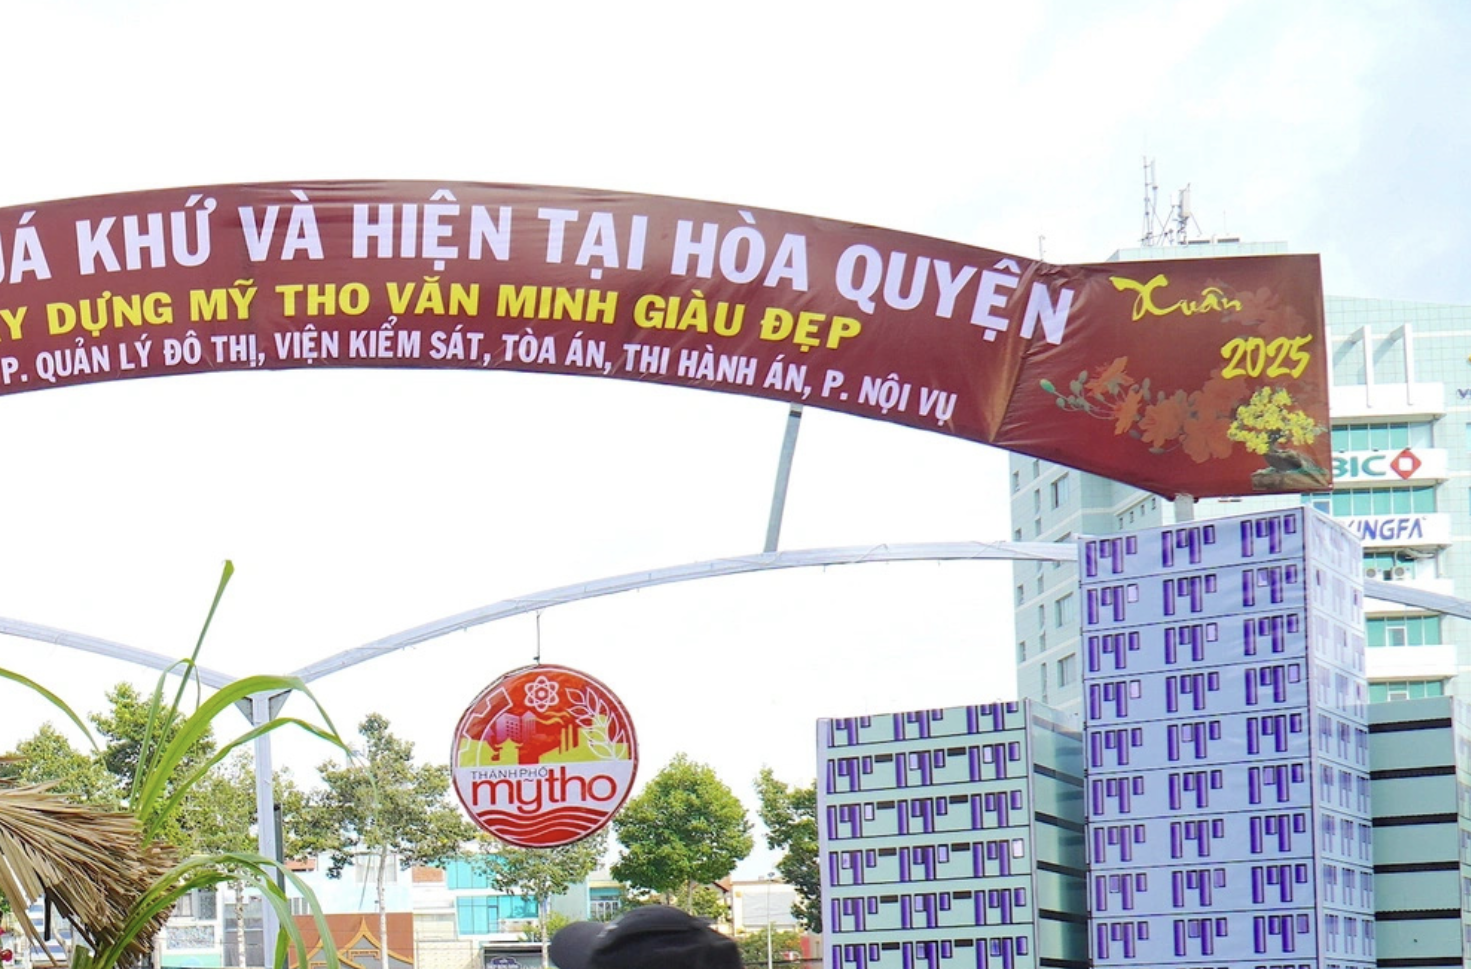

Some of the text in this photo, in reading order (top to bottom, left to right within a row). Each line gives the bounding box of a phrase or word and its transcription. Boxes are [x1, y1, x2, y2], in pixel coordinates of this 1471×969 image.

[75, 194, 217, 274] KHỨ
[238, 189, 324, 263] VÀ
[351, 188, 511, 271] HIỆN
[537, 207, 649, 280] TẠI
[670, 210, 809, 292] HÒA
[835, 243, 1075, 346] QUYỆN
[1108, 273, 1243, 322] Xuân
[46, 290, 174, 338] DỰNG
[189, 278, 258, 321] MỸ
[275, 282, 371, 317] THO
[385, 275, 480, 316] VĂN
[496, 284, 619, 325] MINH
[633, 288, 746, 337] GIÀU
[759, 306, 862, 353] ĐẸP
[0, 355, 28, 385] P.
[35, 337, 111, 383] QUẢN
[118, 332, 153, 371] LÝ
[163, 330, 203, 366] ĐÔ
[210, 333, 266, 368] THỊ,
[274, 323, 340, 365] VIỆN
[348, 315, 422, 360] KIỂM
[429, 323, 492, 367] SÁT,
[501, 327, 557, 365] TÒA
[564, 331, 612, 375] ÁN,
[623, 343, 671, 375] THI
[677, 344, 758, 386] HÀNH
[762, 354, 812, 400] ÁN,
[821, 369, 849, 401] P.
[858, 372, 912, 415] NỘI
[917, 387, 958, 427] VỤ
[1220, 333, 1313, 380] 2025
